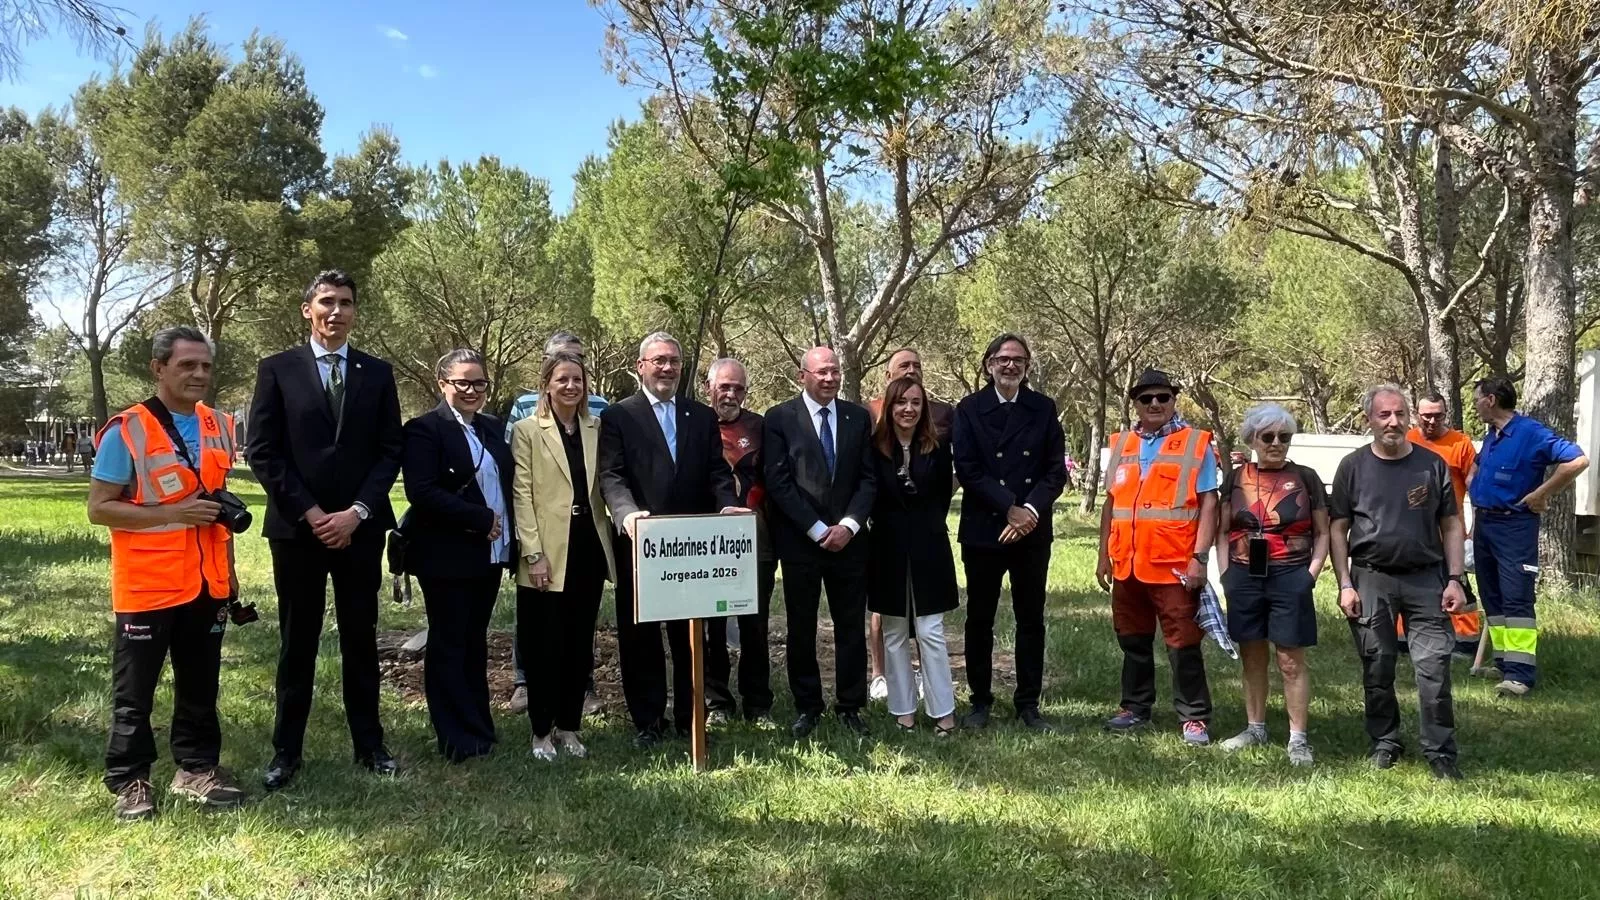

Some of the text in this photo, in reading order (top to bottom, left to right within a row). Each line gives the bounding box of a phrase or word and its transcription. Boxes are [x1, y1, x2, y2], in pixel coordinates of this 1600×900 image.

[643, 538, 656, 558] Os
[659, 537, 707, 558] Andarines
[660, 567, 738, 582] Jorgeada 2026
